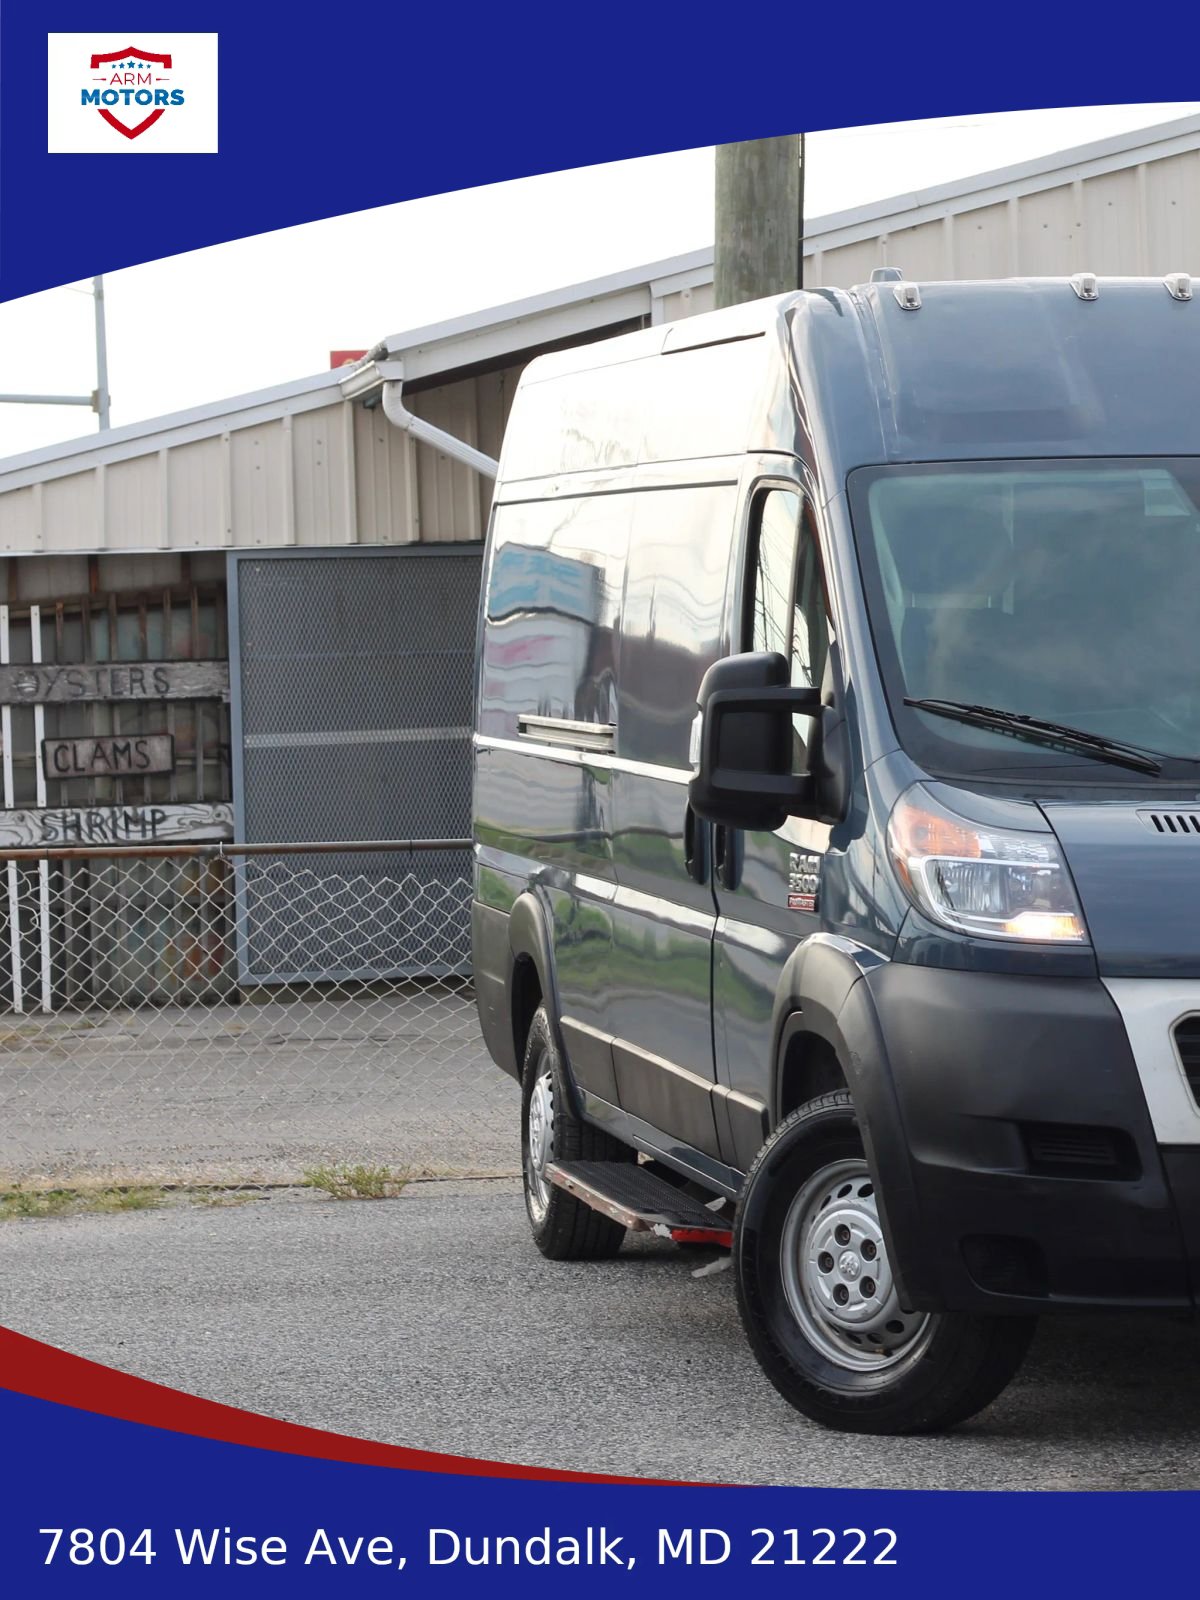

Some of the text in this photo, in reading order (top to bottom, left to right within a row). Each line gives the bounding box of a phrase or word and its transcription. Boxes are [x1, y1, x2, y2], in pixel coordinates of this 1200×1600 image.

[15, 667, 170, 697] OYSTERS
[53, 740, 151, 773] CLAMS
[40, 808, 166, 842] SHRIMP
[789, 852, 820, 874] RAM
